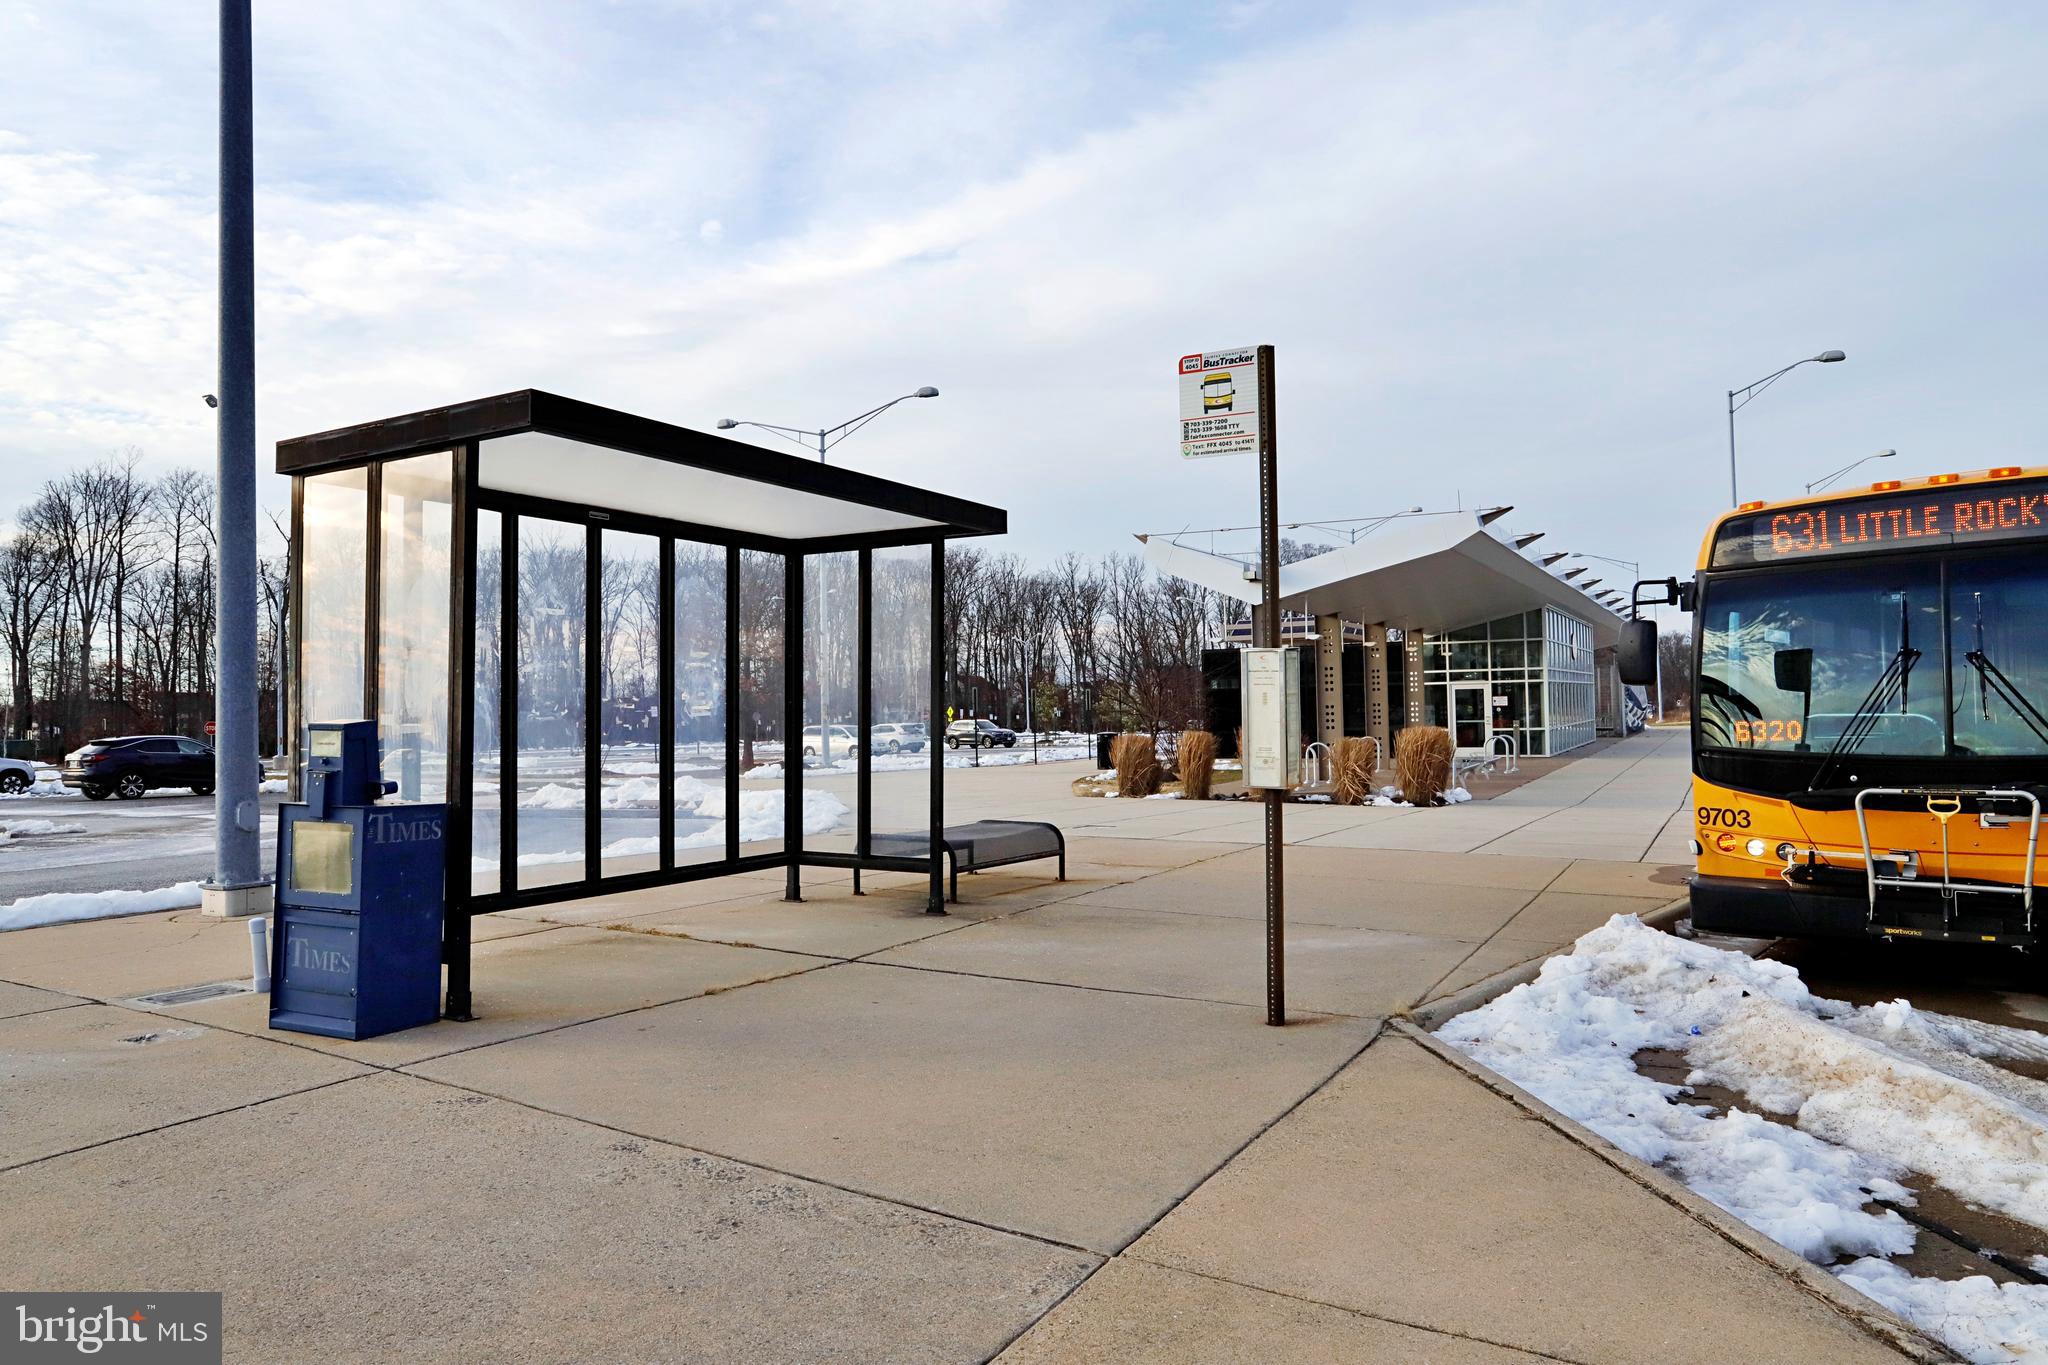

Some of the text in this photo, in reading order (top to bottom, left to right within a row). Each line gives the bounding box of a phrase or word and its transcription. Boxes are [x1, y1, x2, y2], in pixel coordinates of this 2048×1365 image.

[1203, 354, 1254, 368] BusTracker
[1190, 418, 1228, 427] 703-339-7200
[1190, 430, 1245, 439] fairfaxconnector.com
[1770, 510, 1832, 553] 631
[1839, 505, 1941, 543] LITTLE
[1698, 806, 1751, 828] 9703
[368, 812, 441, 844] TIMES
[1885, 927, 1922, 937] sportworks
[288, 936, 350, 974] TIMES
